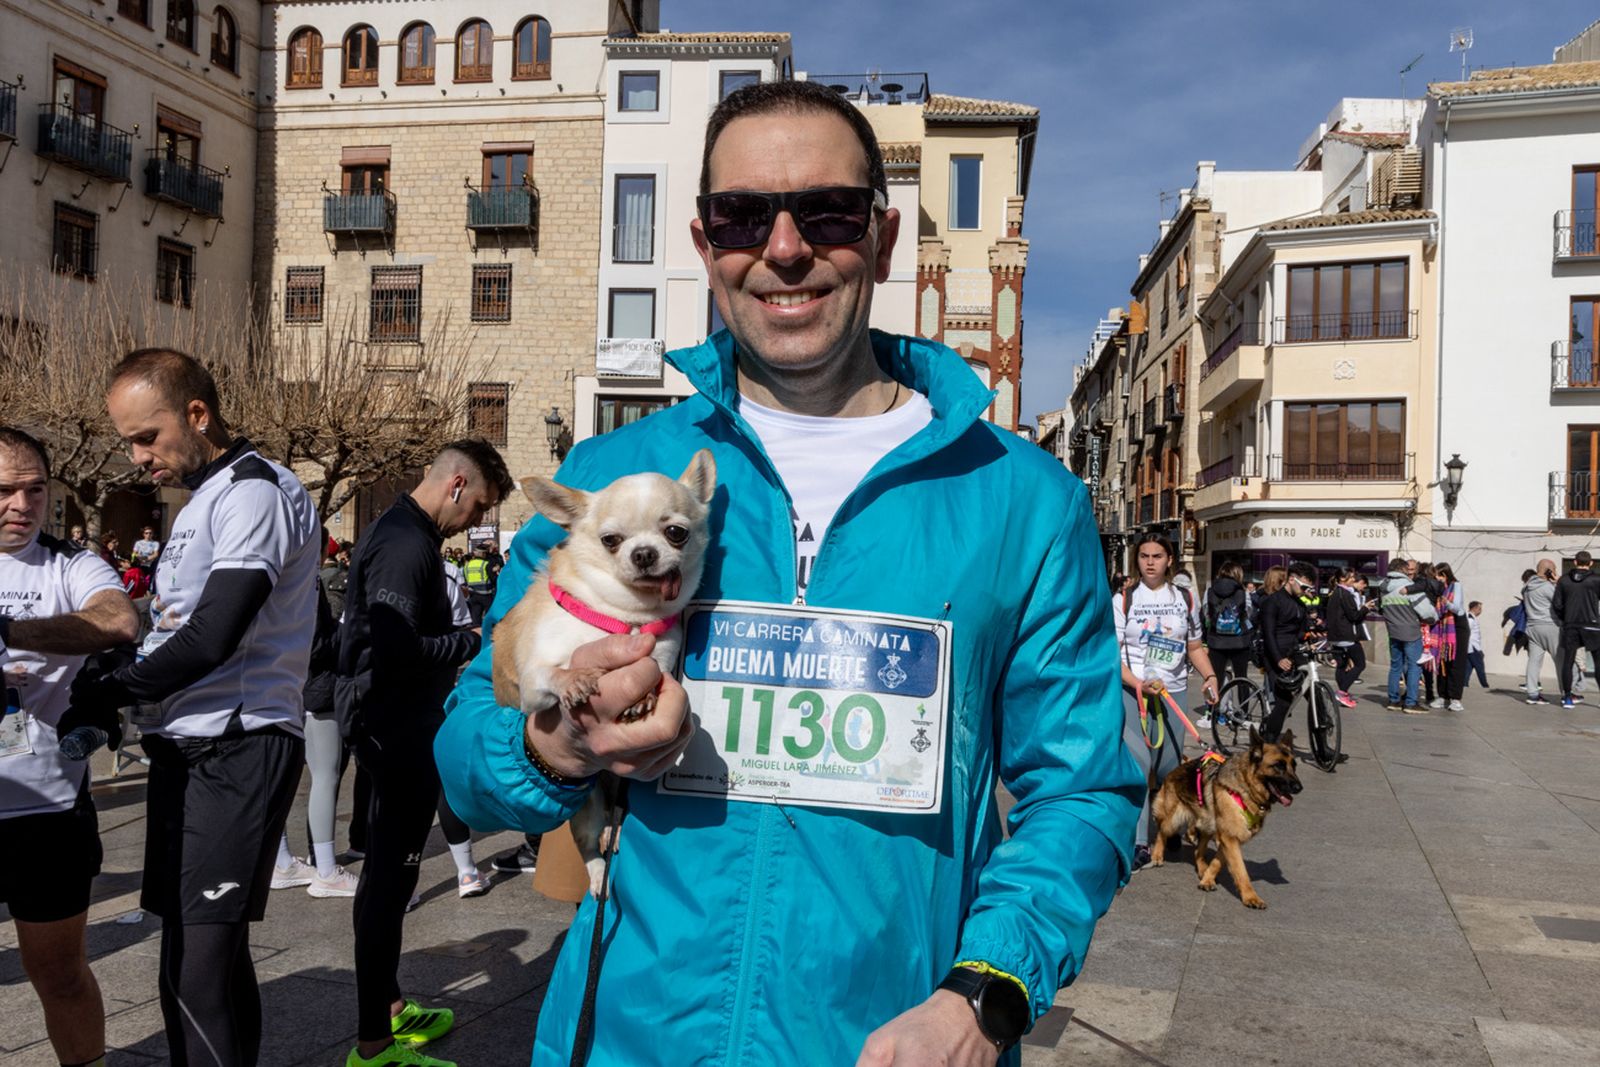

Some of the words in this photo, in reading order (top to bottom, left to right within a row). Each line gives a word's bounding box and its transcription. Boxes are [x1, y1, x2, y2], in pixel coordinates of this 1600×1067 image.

[1311, 528, 1341, 538] PADRE
[1356, 528, 1388, 538] JESUS
[376, 588, 416, 613] GORE
[714, 620, 732, 635] VI
[734, 621, 814, 643] CARRERA
[819, 629, 912, 652] CAMINATA
[708, 646, 775, 677] BUENA
[782, 653, 868, 683] MUERTE
[1149, 648, 1174, 662] 1128
[721, 686, 887, 764] 1130
[741, 758, 781, 770] MIGUEL
[814, 761, 858, 775] JIMÉNEZ
